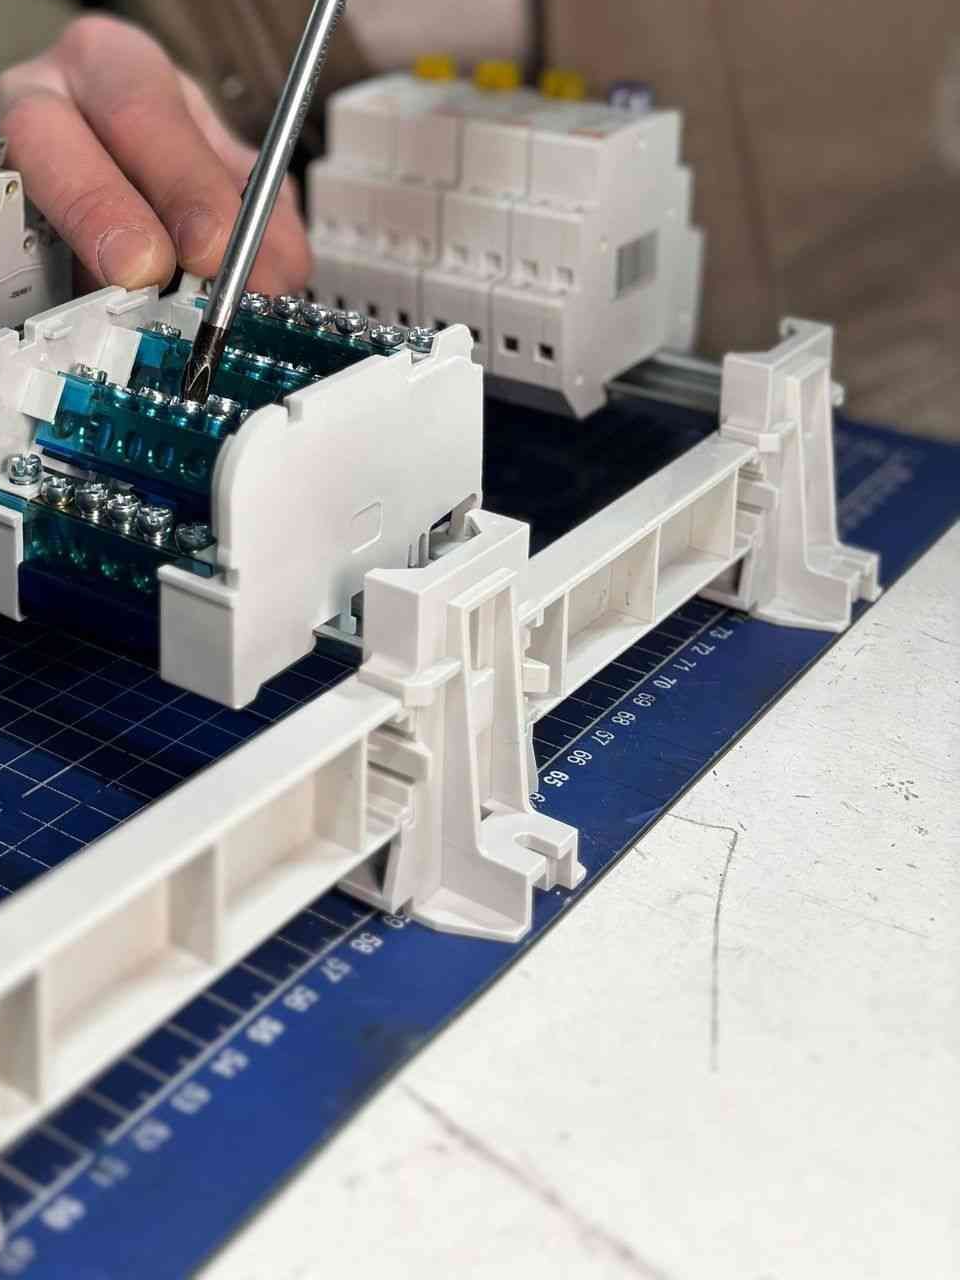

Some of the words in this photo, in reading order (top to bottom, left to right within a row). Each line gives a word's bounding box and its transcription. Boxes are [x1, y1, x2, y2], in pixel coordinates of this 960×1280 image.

[691, 642, 716, 655] 72
[673, 658, 697, 671] 71
[653, 675, 677, 689] 70
[633, 692, 656, 707] 69
[611, 711, 636, 726] 68
[592, 730, 615, 746] 67
[567, 750, 593, 766] 66
[543, 770, 570, 787] 65
[349, 932, 384, 955] 58
[321, 957, 352, 983] 57
